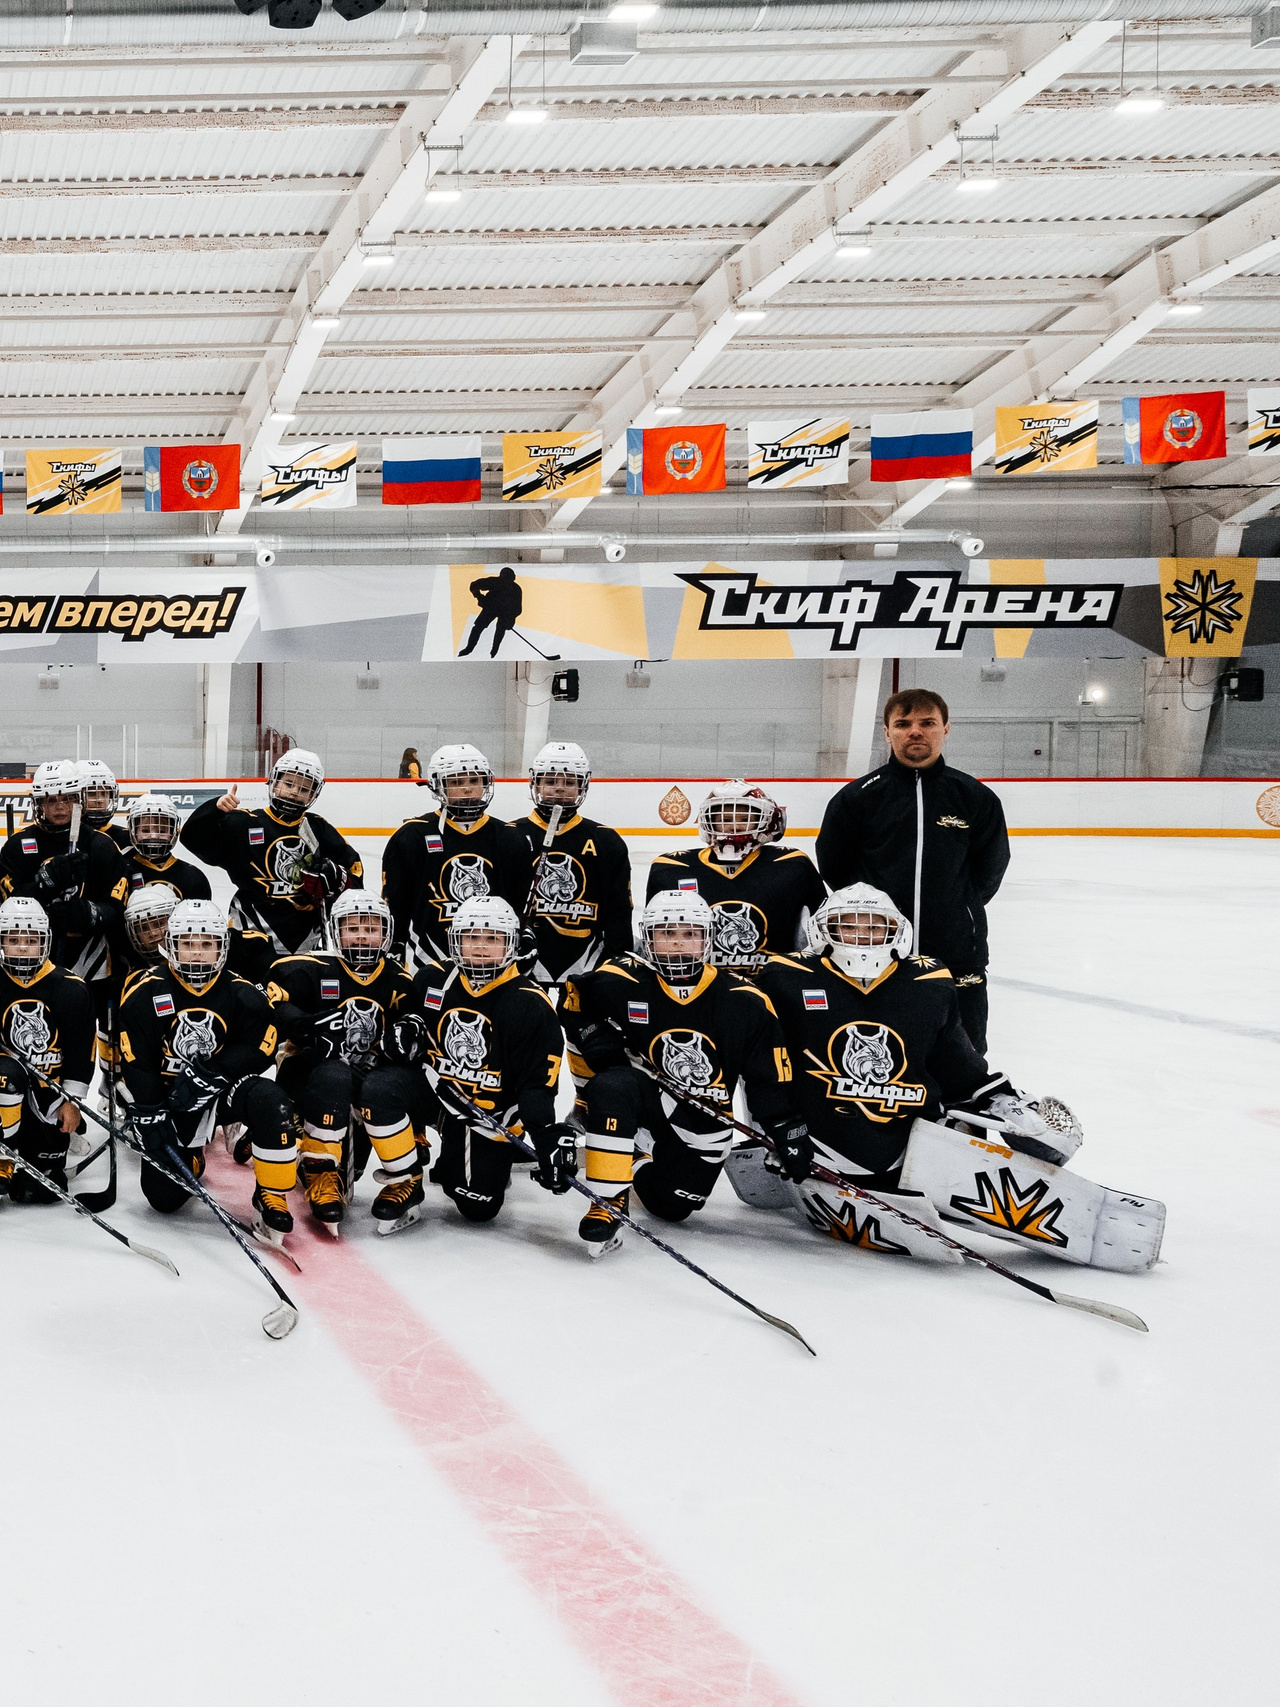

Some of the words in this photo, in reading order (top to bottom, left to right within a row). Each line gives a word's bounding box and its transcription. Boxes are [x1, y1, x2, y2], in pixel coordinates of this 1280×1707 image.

[1022, 418, 1070, 435] Скифы
[527, 446, 575, 462] Скифы
[761, 443, 843, 465] Скифы
[49, 460, 96, 478] Скифы
[277, 465, 349, 489] Скифы
[56, 593, 239, 638] вперед!
[703, 581, 880, 644] Скиф
[580, 838, 598, 857] A
[388, 989, 407, 1010] K
[678, 989, 689, 1000] 13
[773, 1046, 793, 1083] 13
[834, 1077, 923, 1109] Скифы
[322, 1113, 333, 1126] 91
[605, 1117, 618, 1131] 13
[280, 1132, 288, 1145] 9
[38, 1150, 67, 1159] CCM
[454, 1186, 493, 1202] CCM
